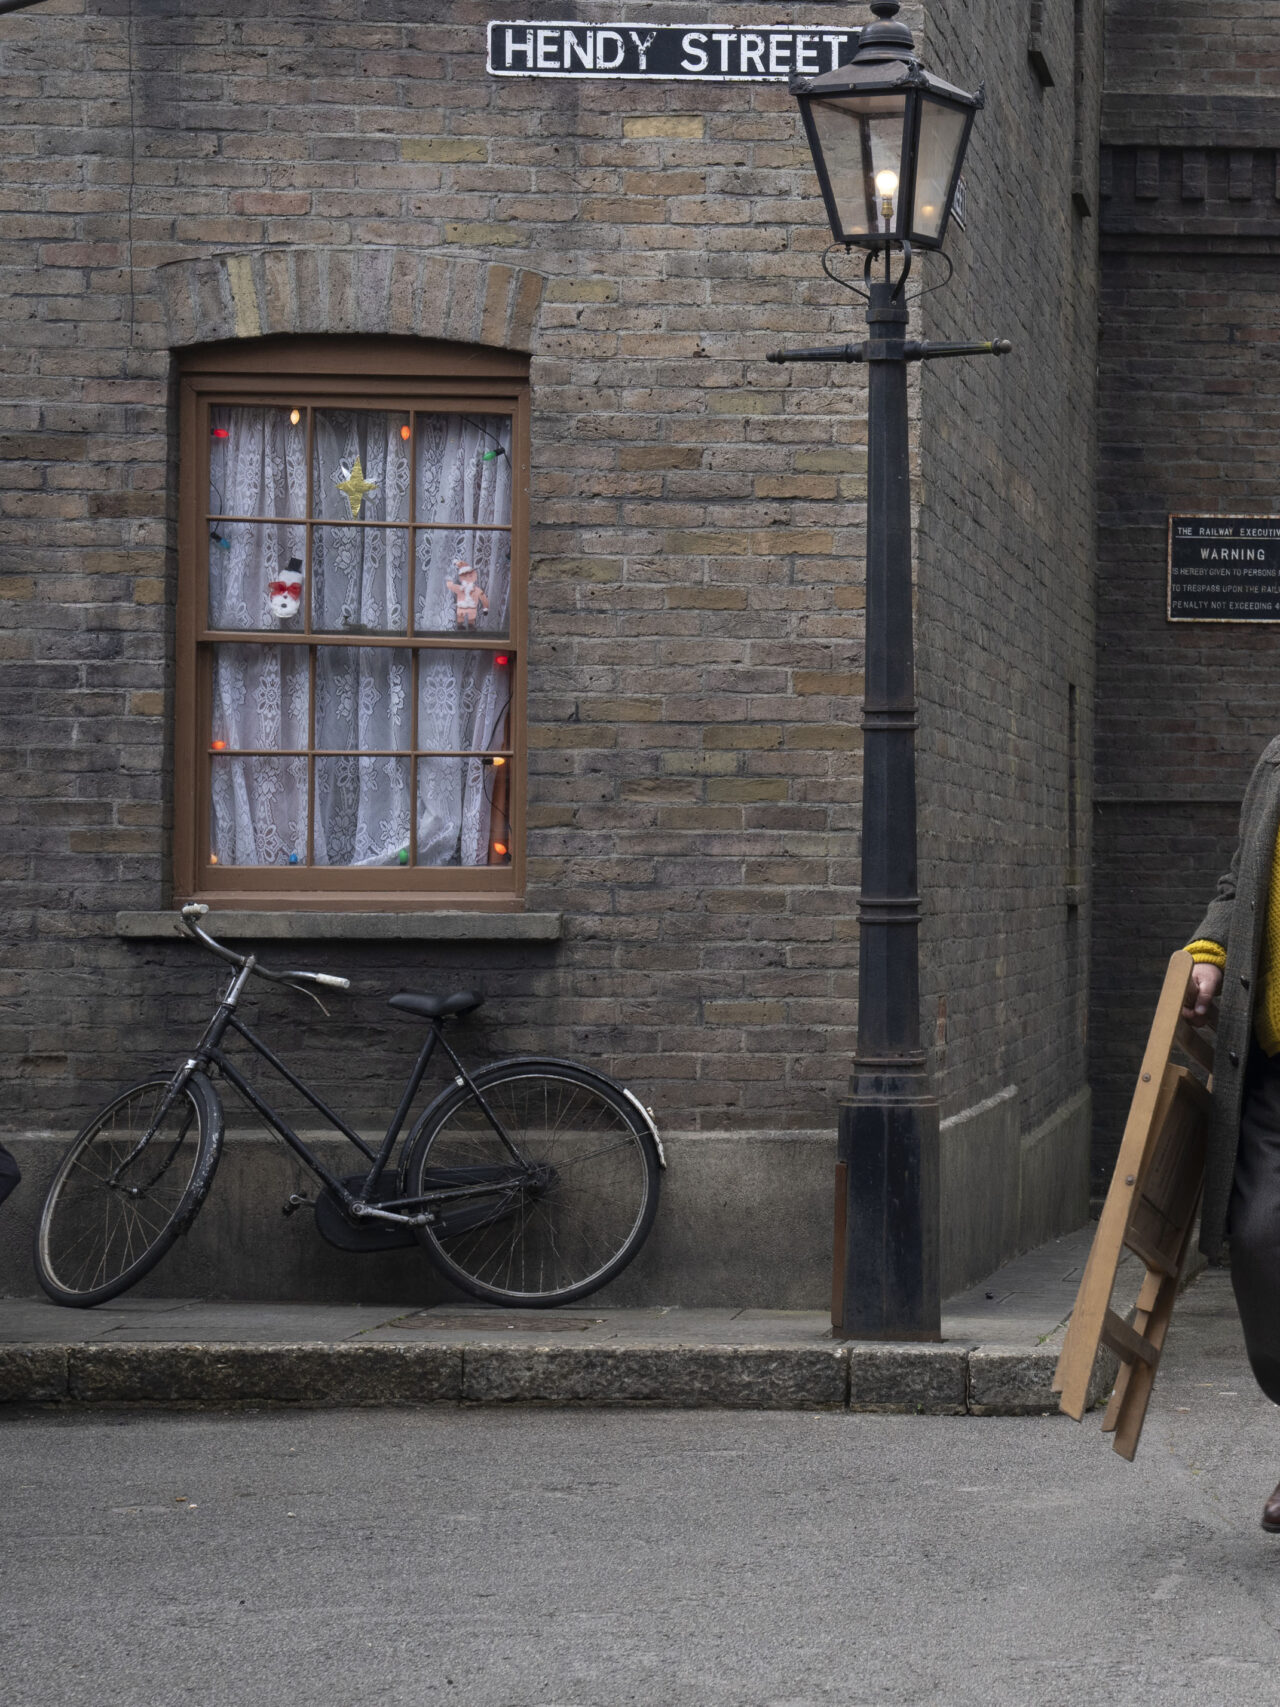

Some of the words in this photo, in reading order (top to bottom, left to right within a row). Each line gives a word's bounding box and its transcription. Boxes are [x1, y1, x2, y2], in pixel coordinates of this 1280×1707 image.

[504, 28, 657, 71] HENDY
[680, 32, 848, 74] STREET
[1177, 526, 1193, 536] THE
[1199, 527, 1233, 536] RAILWAY
[1200, 547, 1266, 561] WARNING
[1180, 567, 1208, 576] HEREBY
[1208, 568, 1231, 577] GIVEN
[1233, 568, 1242, 577] TO
[1243, 568, 1277, 577] PERSONS
[1171, 584, 1181, 592] TO
[1182, 584, 1221, 593] TRESPASS
[1222, 584, 1243, 593] UPON
[1245, 585, 1259, 594] THE
[1172, 600, 1208, 609] PENALTY
[1211, 601, 1226, 610] NOT
[1229, 601, 1273, 610] EXCEEDING
